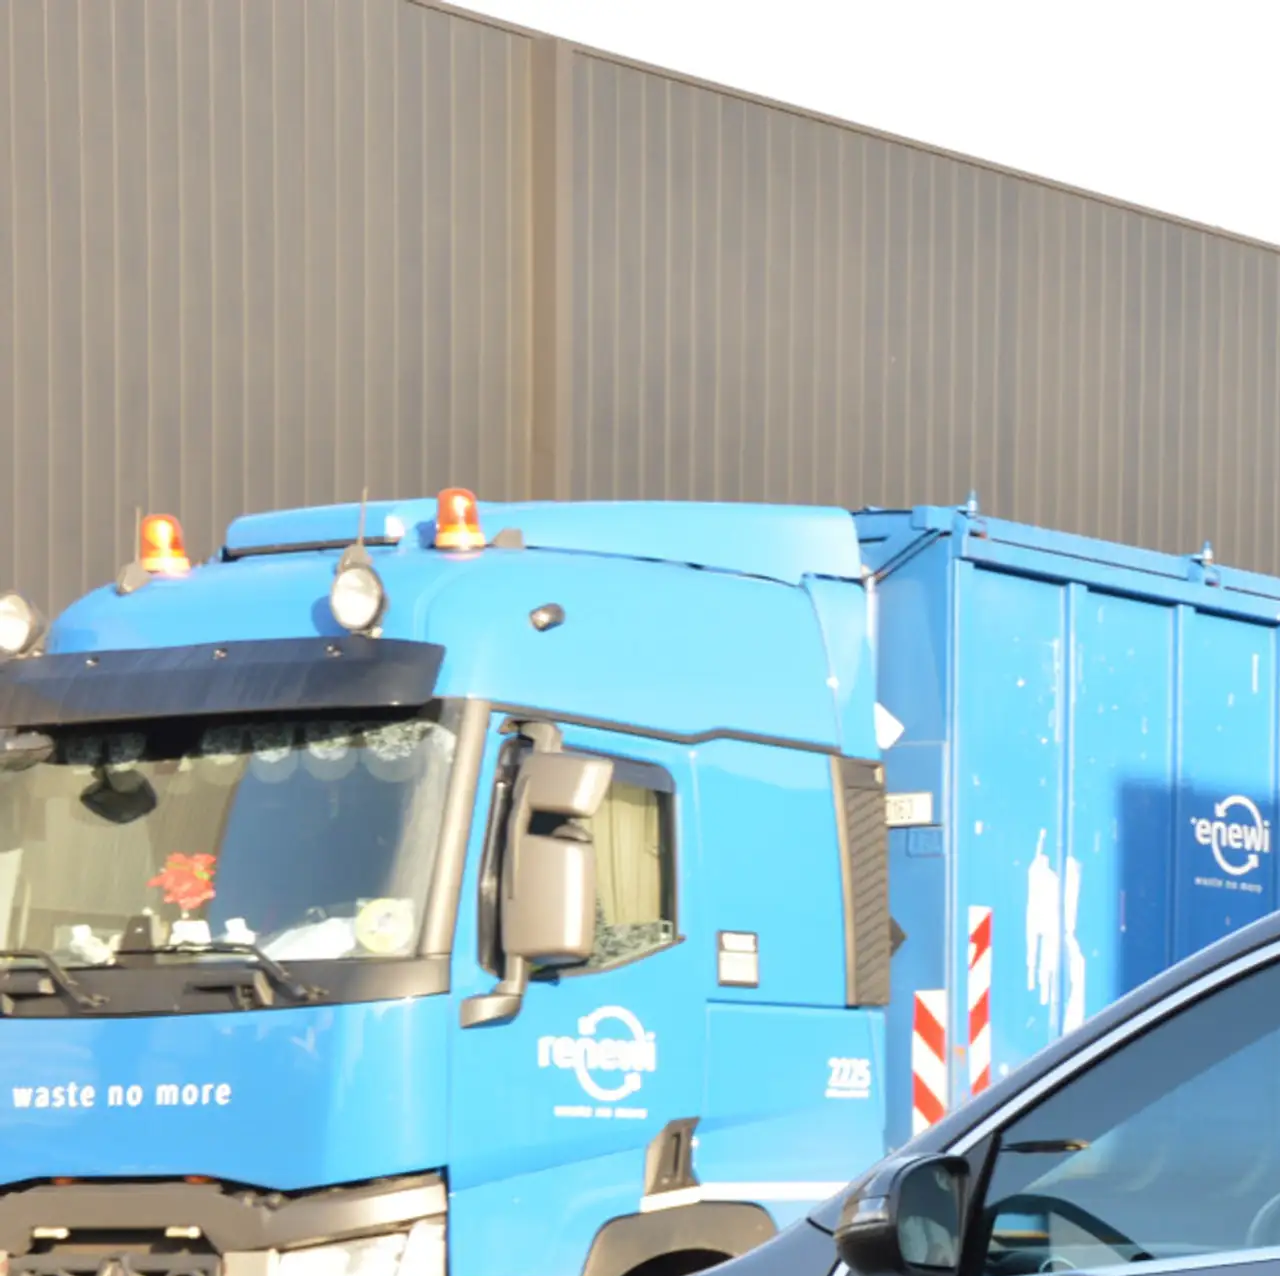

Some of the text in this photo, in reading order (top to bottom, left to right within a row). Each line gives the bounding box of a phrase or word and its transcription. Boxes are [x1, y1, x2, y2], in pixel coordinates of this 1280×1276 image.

[1190, 817, 1270, 853] enewi
[12, 1081, 233, 1108] waste no more
